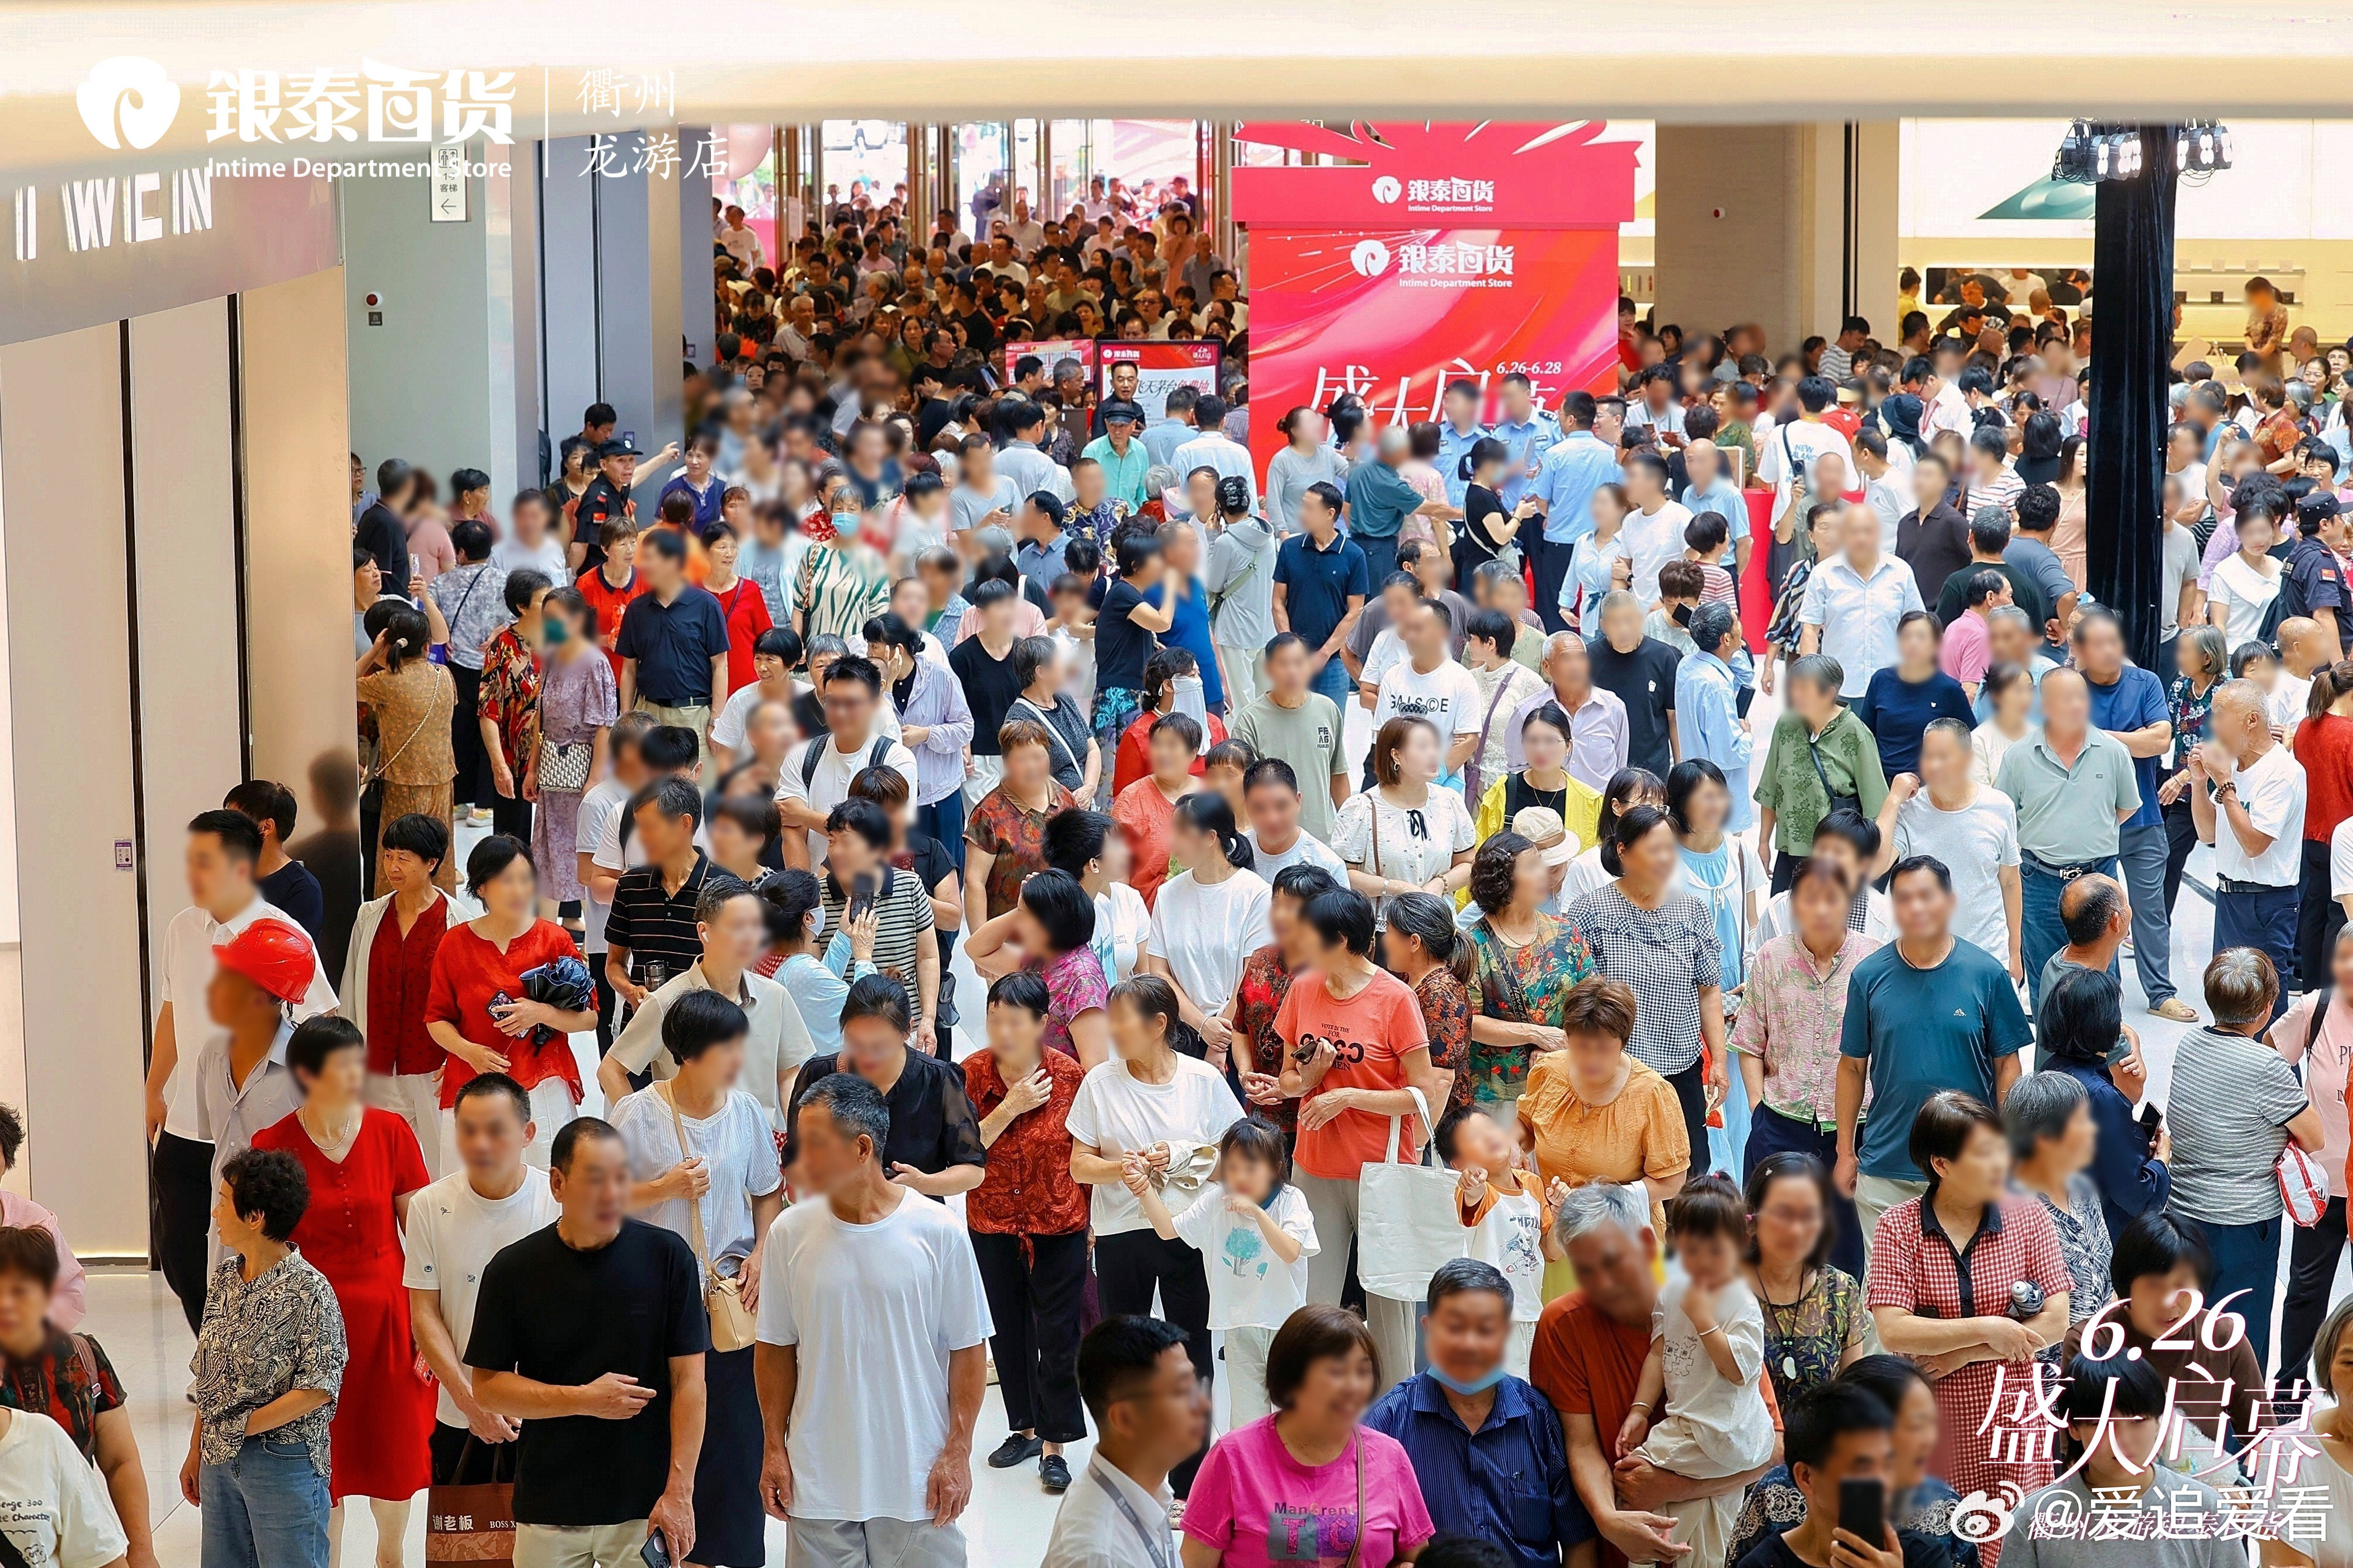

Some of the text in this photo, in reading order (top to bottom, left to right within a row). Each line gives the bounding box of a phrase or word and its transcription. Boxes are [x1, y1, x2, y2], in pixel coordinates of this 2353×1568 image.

[440, 184, 458, 193] 客梯
[1407, 176, 1494, 203] 银泰百货
[1431, 205, 1473, 213] Department
[1398, 240, 1514, 275] 银泰百货
[1399, 279, 1513, 289] Intime Department Store
[1496, 361, 1562, 376] 6.26-6.28
[432, 1514, 474, 1531] 谢老板
[490, 1520, 509, 1529] BOSS
